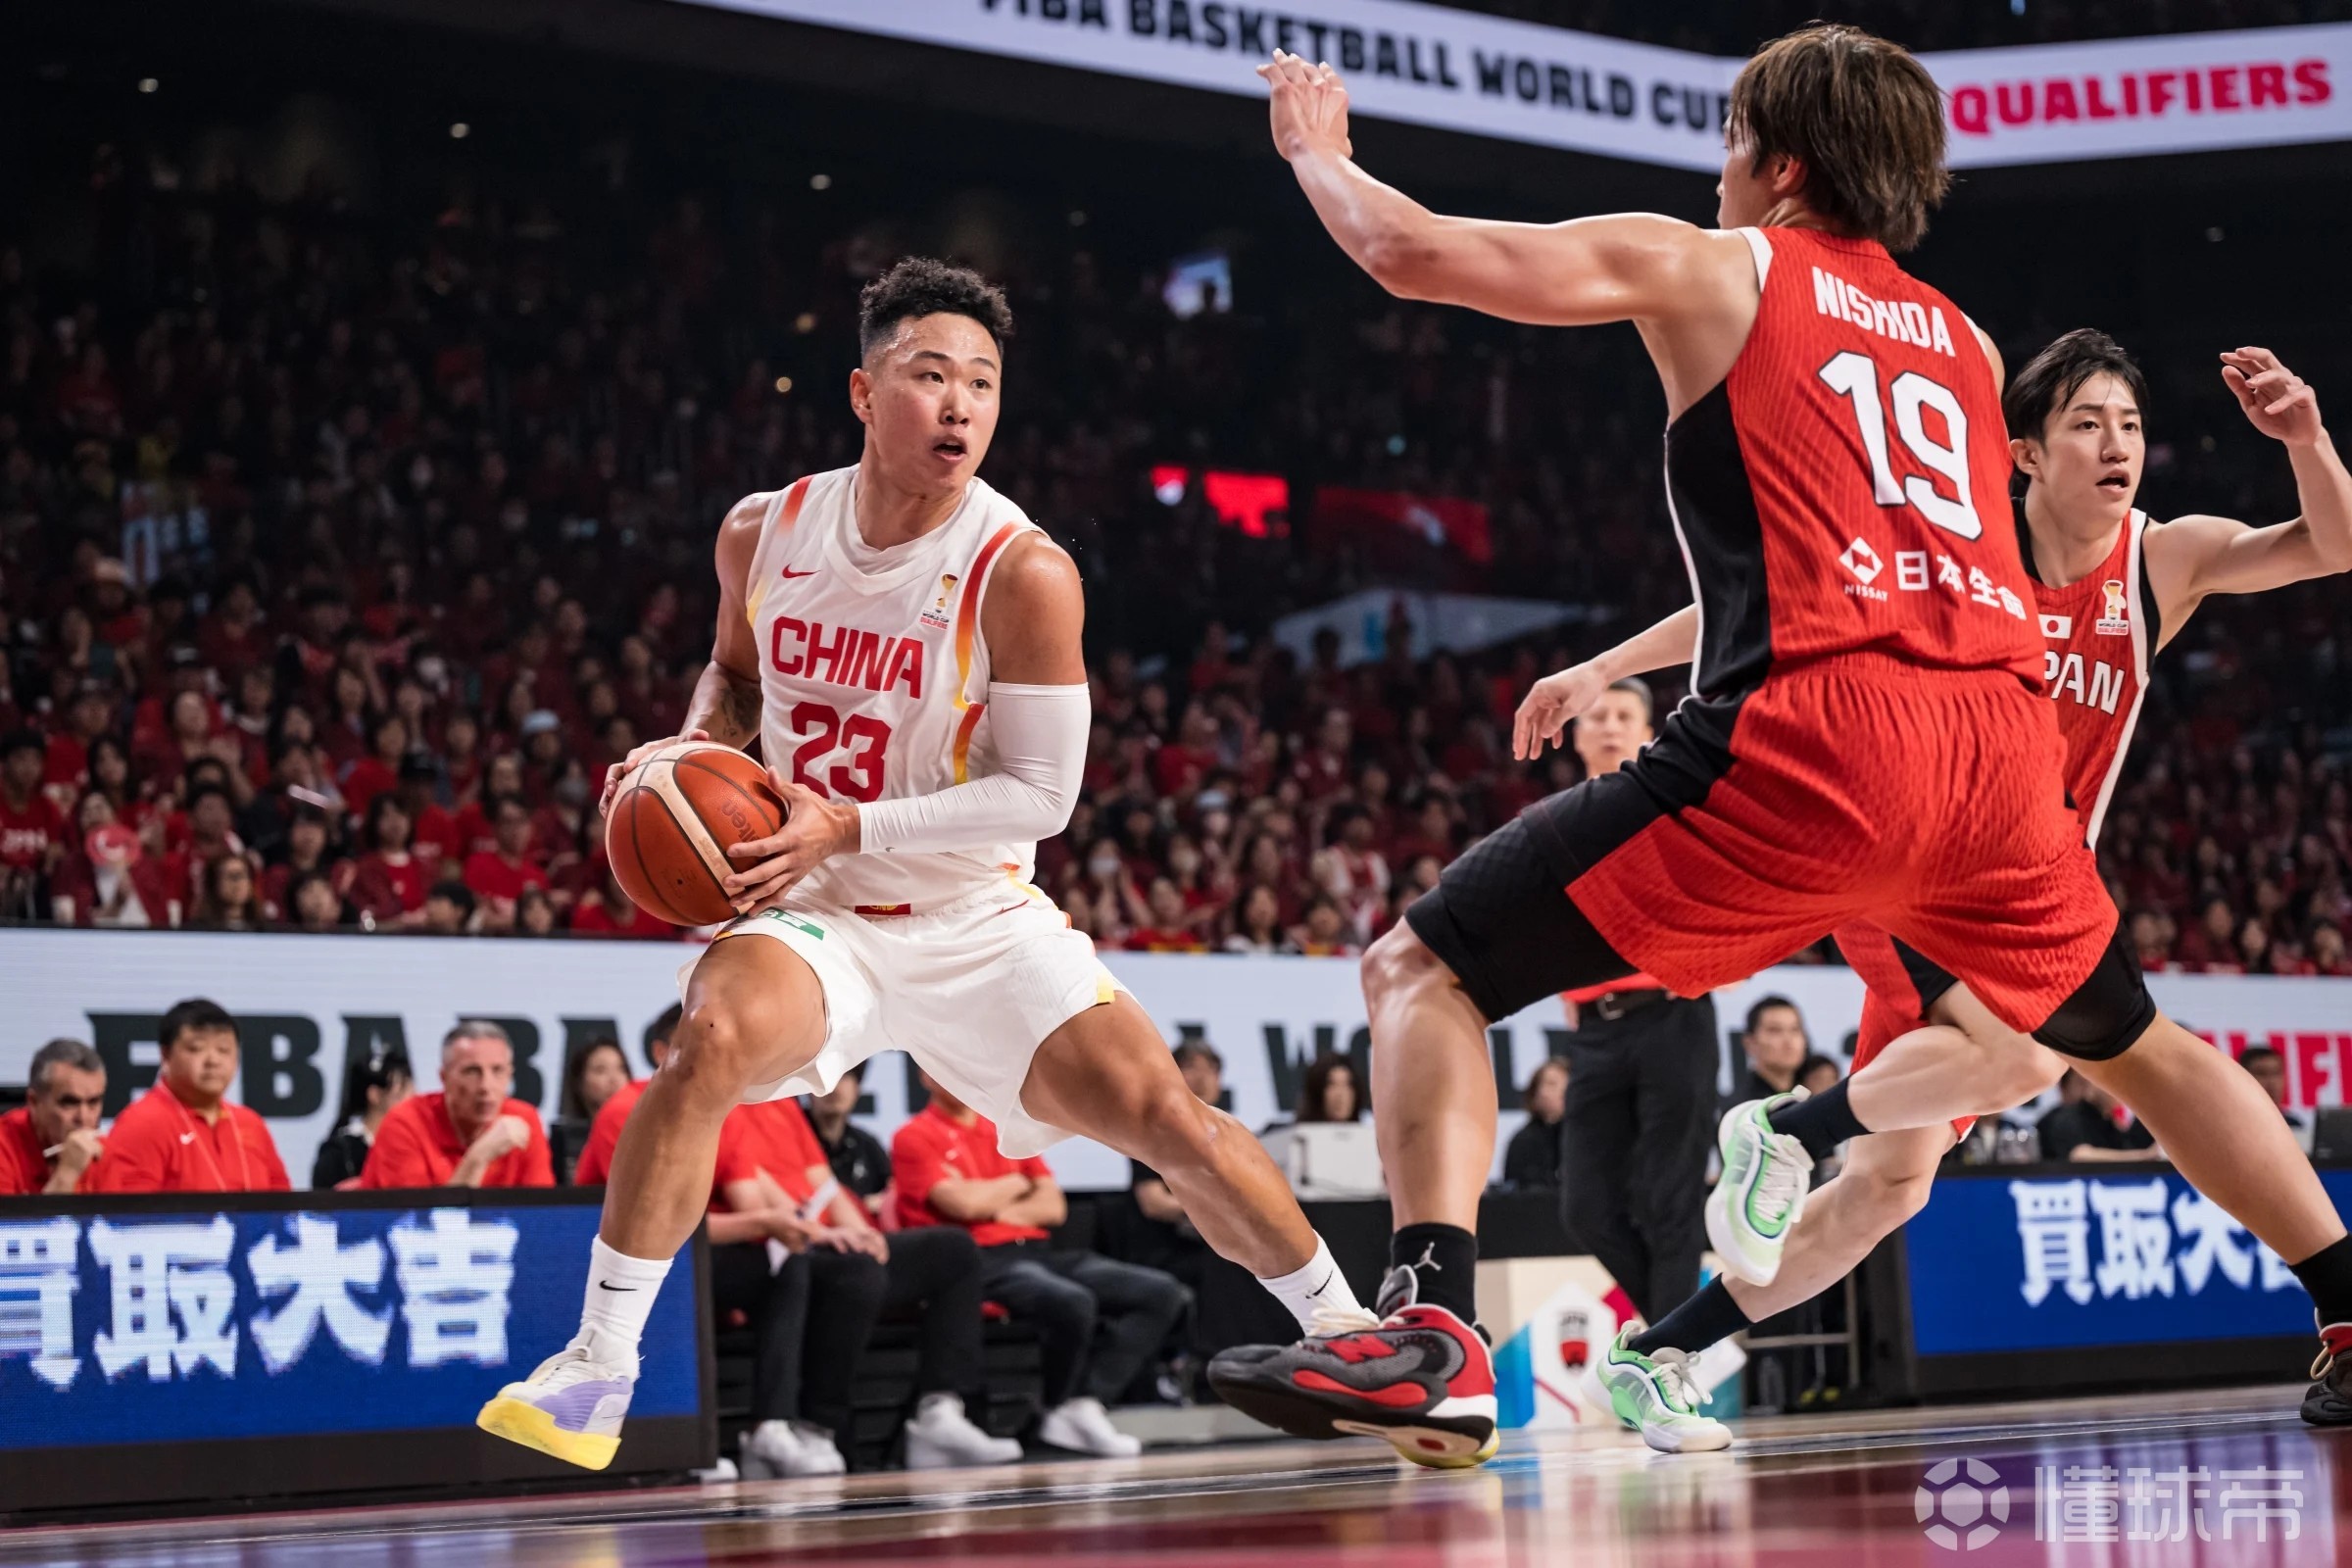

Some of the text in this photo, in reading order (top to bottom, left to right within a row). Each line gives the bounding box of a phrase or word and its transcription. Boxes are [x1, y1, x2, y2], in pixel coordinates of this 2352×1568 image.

[1130, 0, 1459, 88] BASKETBALL
[1474, 48, 1636, 118] WORLD
[1951, 59, 2332, 136] QUALIFIERS
[1812, 266, 1956, 358] NISHIDA
[1817, 349, 1984, 542] 19
[1844, 584, 1888, 602] NISSAY
[1895, 550, 2028, 621] 日本生命
[772, 615, 923, 700] CHINA
[791, 701, 893, 803] 23
[2009, 1177, 2307, 1307] 買取大
